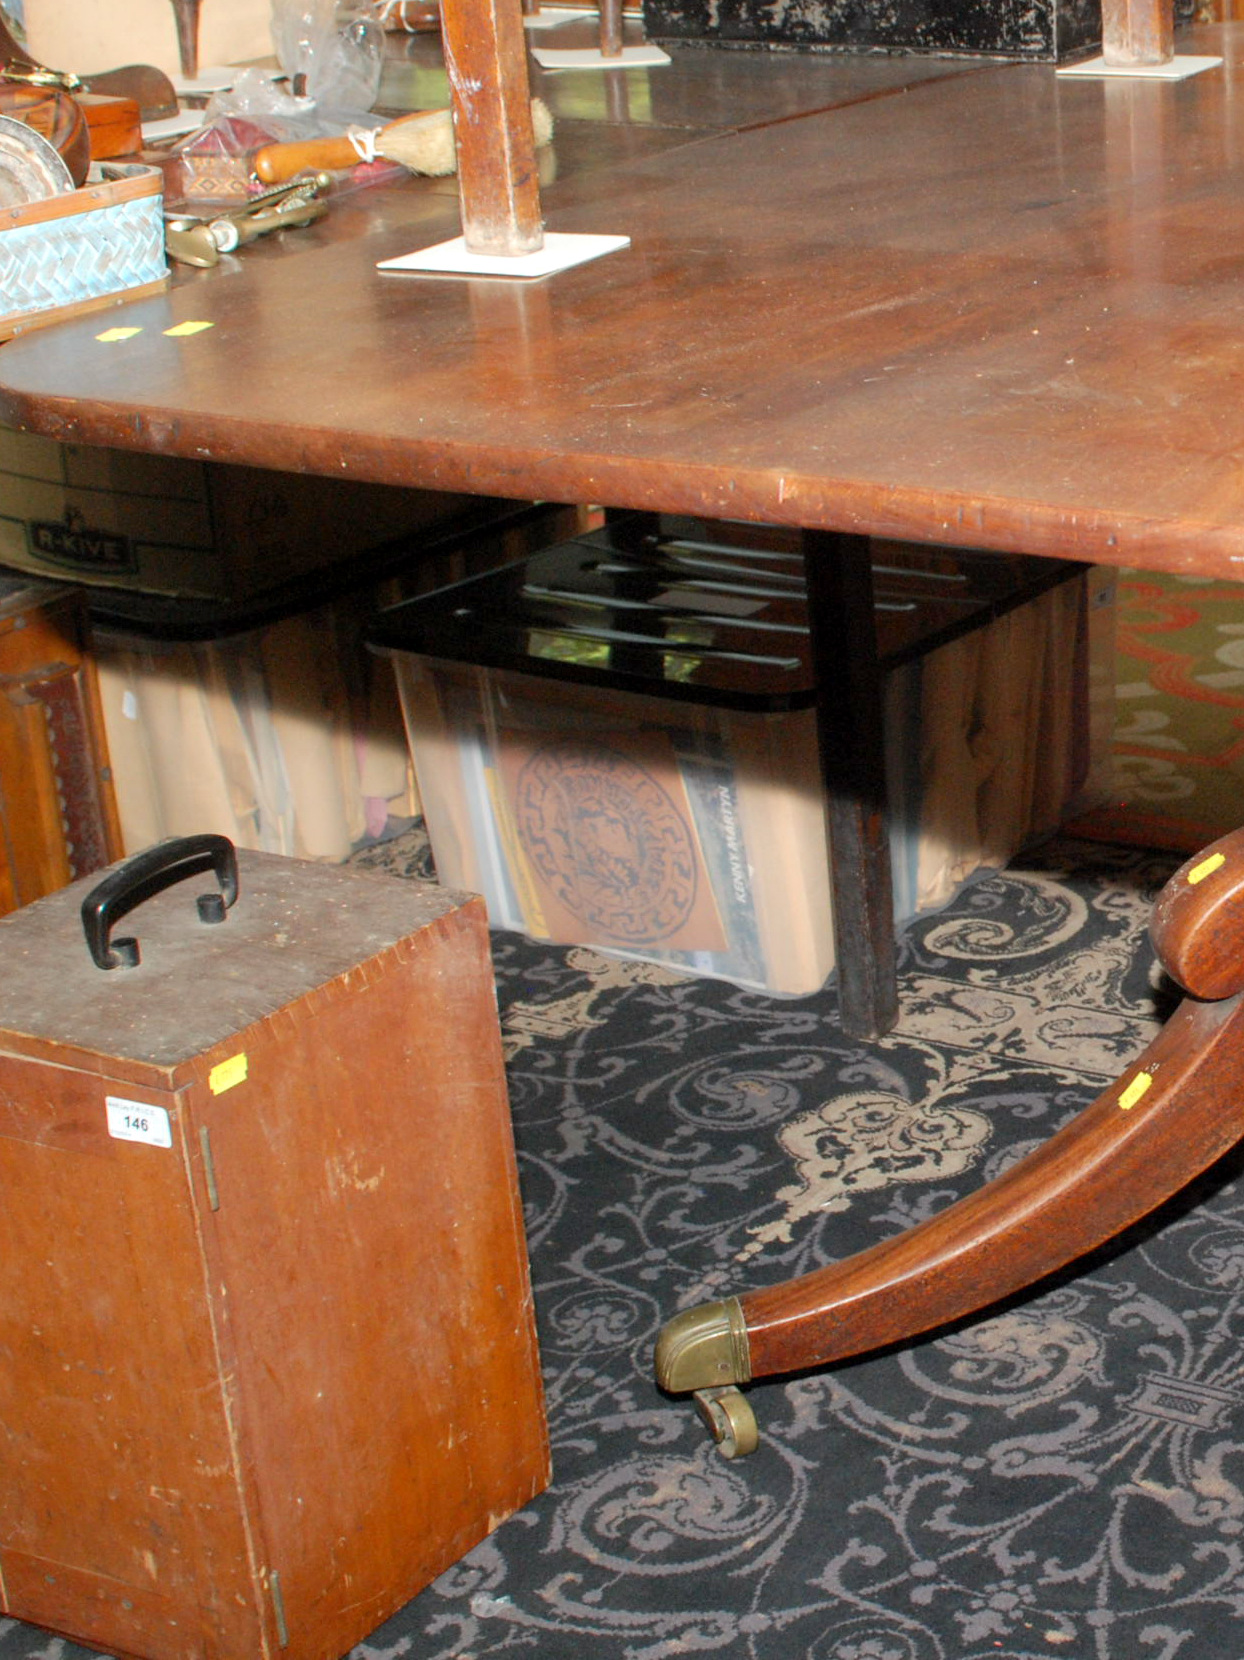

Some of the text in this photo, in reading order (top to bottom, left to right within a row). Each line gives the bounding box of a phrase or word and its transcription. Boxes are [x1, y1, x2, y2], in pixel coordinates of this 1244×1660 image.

[718, 785, 746, 904] KENNY MARTYN
[124, 1115, 149, 1132] 146
